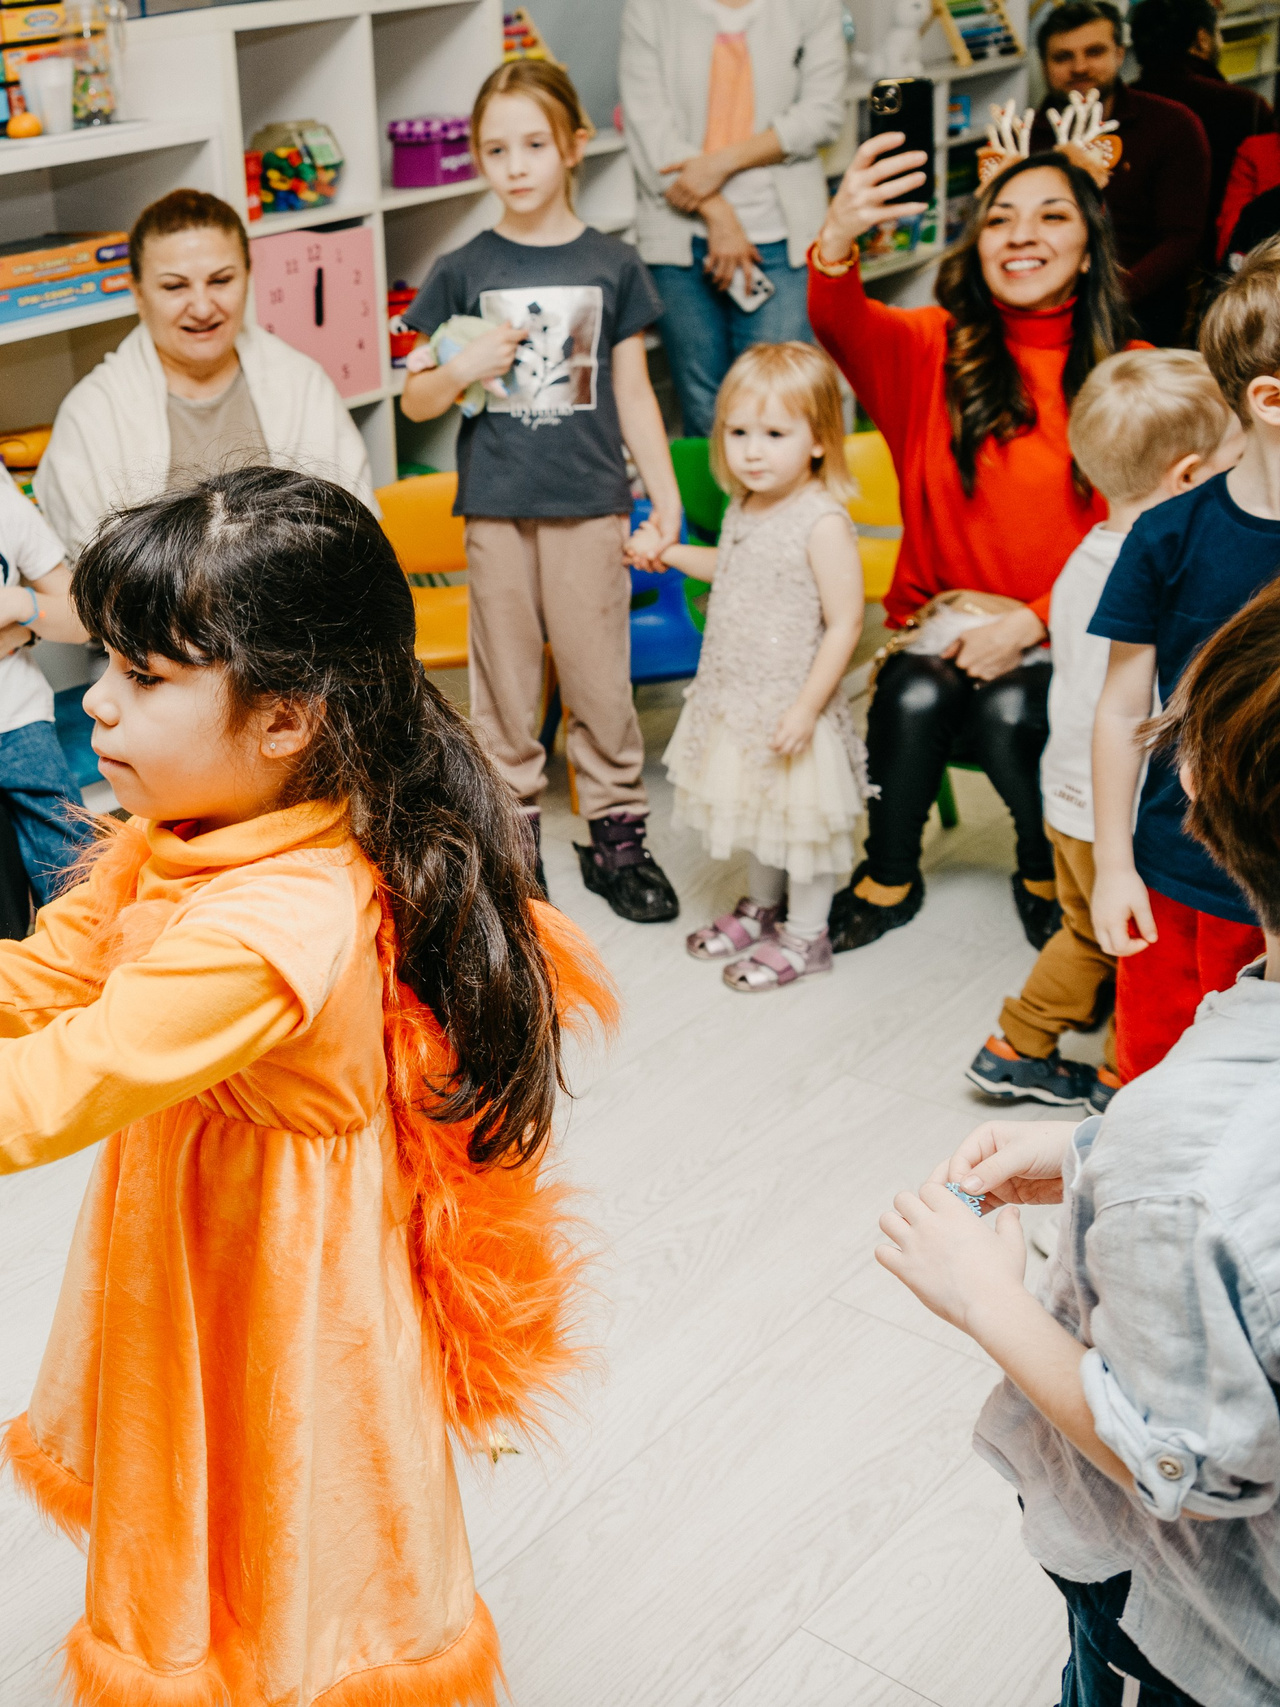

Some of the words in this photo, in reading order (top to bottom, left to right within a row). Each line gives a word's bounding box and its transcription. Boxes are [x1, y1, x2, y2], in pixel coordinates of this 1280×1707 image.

[308, 244, 322, 262] 12
[286, 258, 298, 274] 11
[271, 289, 284, 304] 10
[342, 364, 350, 380] 5
